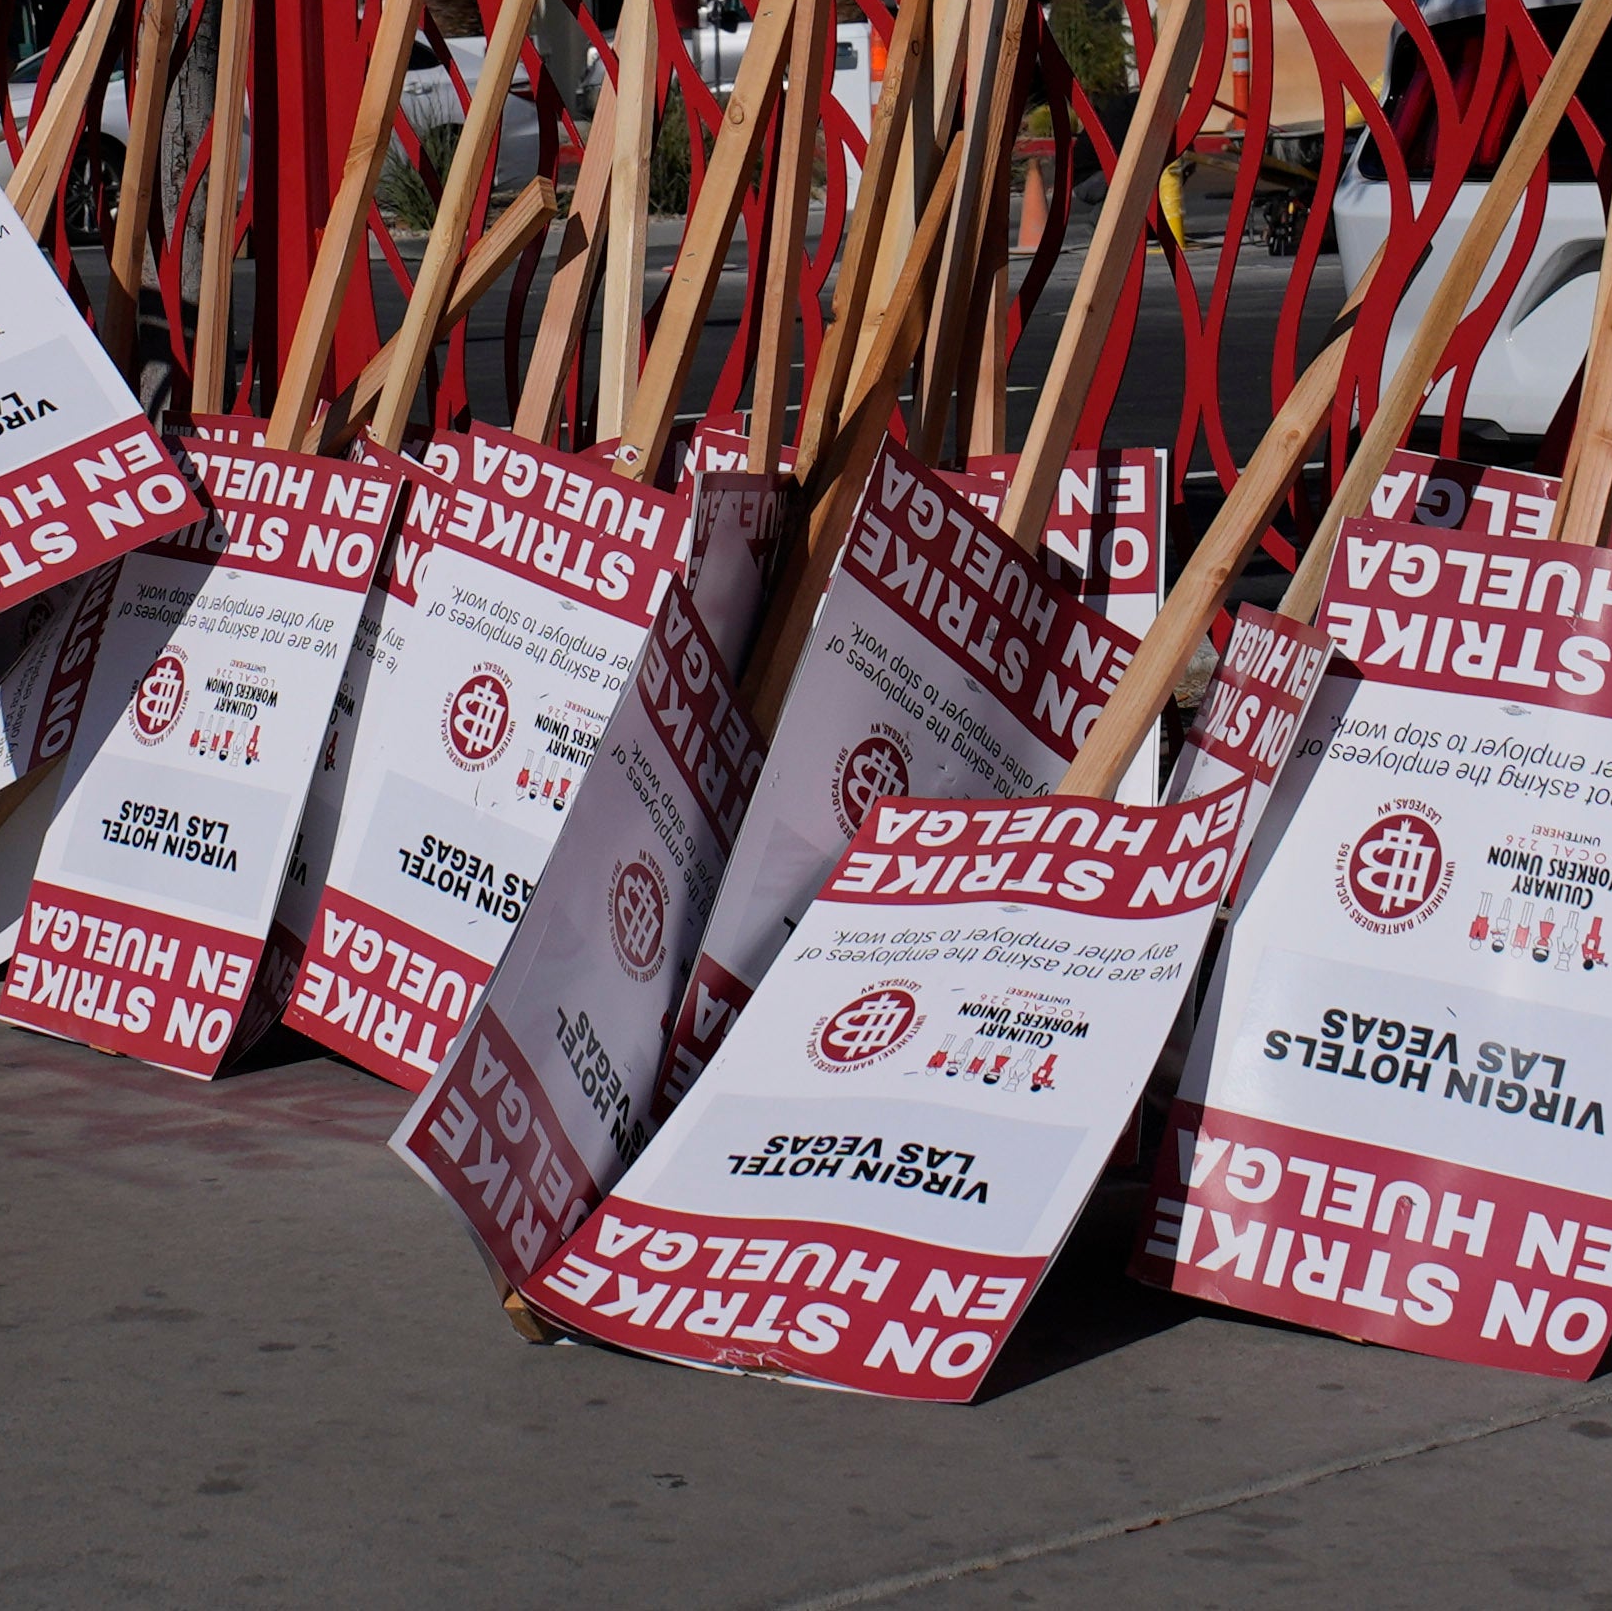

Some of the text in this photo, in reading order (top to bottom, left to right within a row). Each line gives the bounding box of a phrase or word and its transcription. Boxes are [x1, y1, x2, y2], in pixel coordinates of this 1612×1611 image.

[72, 430, 163, 492] EN
[86, 473, 186, 540] ON
[320, 473, 391, 524] EN
[472, 435, 665, 550] HUELGA
[1059, 466, 1146, 516] EN
[296, 523, 374, 578] ON
[445, 488, 635, 601] STRIKE
[880, 452, 1058, 645] HUELGA
[1046, 526, 1150, 581] ON
[850, 508, 1029, 693] STRIKE
[1326, 601, 1611, 696] STRIKE
[1295, 738, 1325, 766] of
[1325, 709, 1387, 741] work.
[1393, 722, 1442, 749] stop
[1446, 733, 1467, 754] to
[1328, 742, 1450, 776] employees
[1455, 762, 1491, 787] the
[1470, 736, 1586, 772] employer
[1496, 763, 1580, 798] asking
[118, 799, 229, 844] LAS VEGAS
[875, 786, 1242, 856] EN HUELGA
[1377, 801, 1391, 817] NV
[1531, 825, 1601, 847] UNITEHERE!
[101, 818, 237, 872] VIRGIN HOTEL
[420, 834, 494, 887] VEGAS
[1486, 845, 1543, 877] UNION
[1505, 834, 1537, 851] 226
[397, 848, 472, 902] HOTEL
[832, 844, 1227, 907] ON STRIKE
[1335, 842, 1455, 935] UNITEHERE! BARTENDERS LOCAL #165
[1510, 874, 1593, 910] CULINARY
[28, 900, 253, 1001] EN HUELGA
[6, 952, 232, 1054] ON STRIKE
[957, 1002, 1089, 1038] WORKERS UNION
[974, 1021, 1061, 1049] CULINARY
[1320, 1008, 1566, 1089] LAS VEGAS
[1264, 1030, 1604, 1135] VIRGIN HOTELS
[727, 1147, 988, 1204] VIRGIN HOTEL
[763, 1134, 975, 1175] LAS VEGAS
[1177, 1128, 1495, 1258] HUELGA
[594, 1213, 1026, 1320] EN HUELGA
[1145, 1196, 1607, 1355] ON STRIKE
[542, 1252, 992, 1378] ON STRIKE
